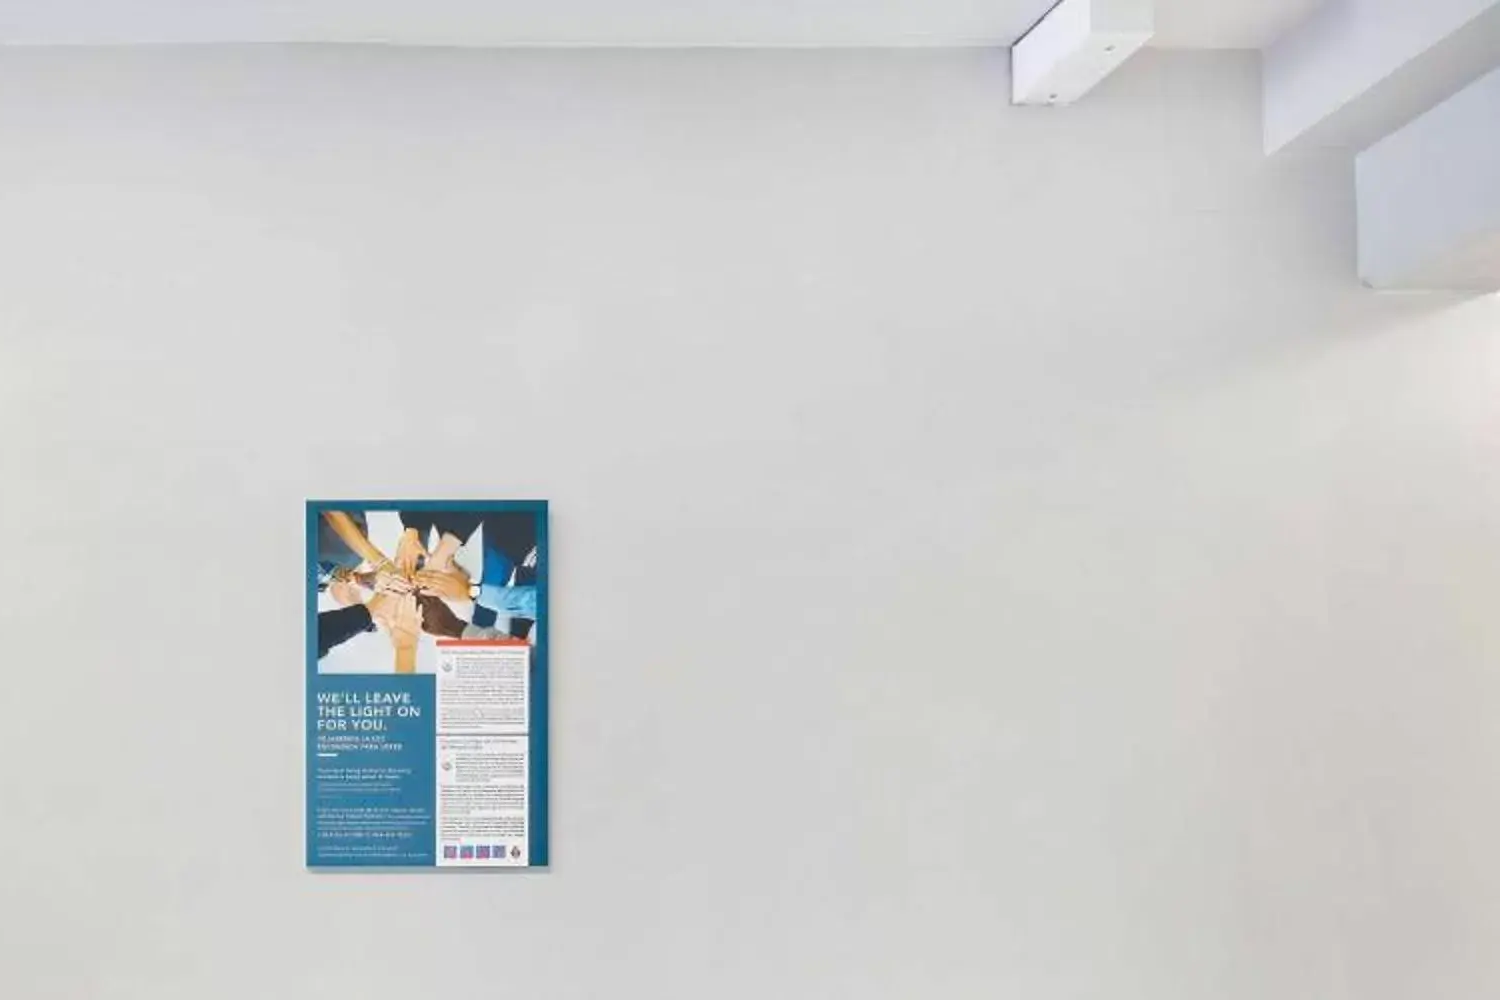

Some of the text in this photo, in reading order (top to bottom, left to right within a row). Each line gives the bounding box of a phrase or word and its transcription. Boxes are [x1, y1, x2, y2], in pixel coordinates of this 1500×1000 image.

[317, 691, 412, 704] WE'LL LEAVE
[317, 705, 421, 717] THE LIGHT ON
[317, 719, 388, 732] FOR YOU.
